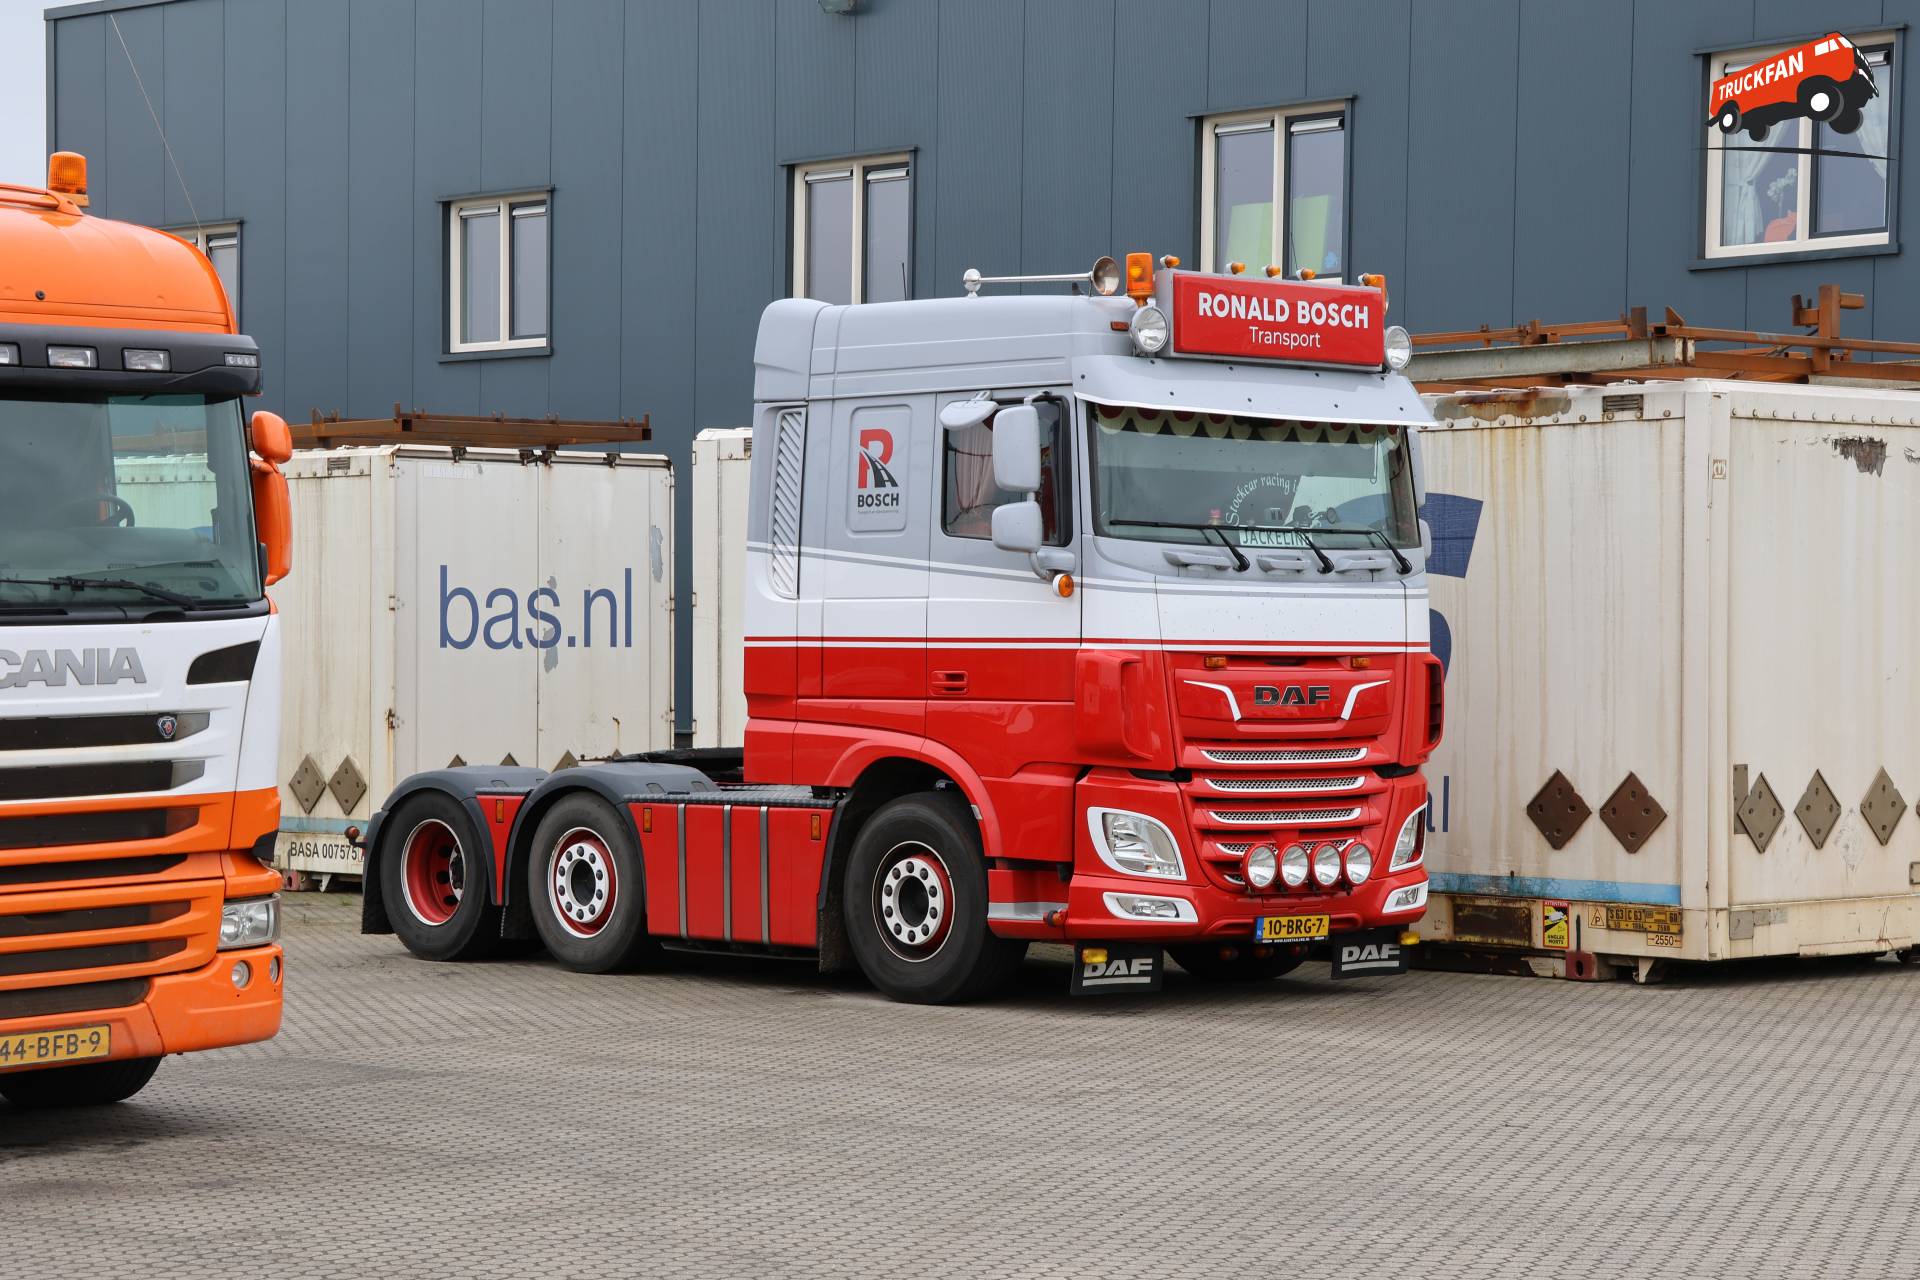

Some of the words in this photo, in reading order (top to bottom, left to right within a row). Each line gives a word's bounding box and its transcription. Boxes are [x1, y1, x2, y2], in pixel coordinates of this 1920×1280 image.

[1198, 292, 1290, 322] RONALD
[1297, 300, 1369, 328] BOSCH
[1249, 326, 1320, 350] Transport
[1260, 472, 1290, 496] racing
[857, 493, 899, 508] BOSCH
[439, 564, 632, 650] bas.nl
[1254, 685, 1330, 705] DAF
[290, 841, 320, 858] BASA
[322, 843, 357, 860] 007575
[1268, 917, 1324, 935] 10-BRG-7
[1655, 934, 1674, 946] 2550
[1342, 943, 1400, 962] DAF
[1084, 958, 1152, 978] DAF
[0, 1031, 101, 1061] 44-BFB-9
